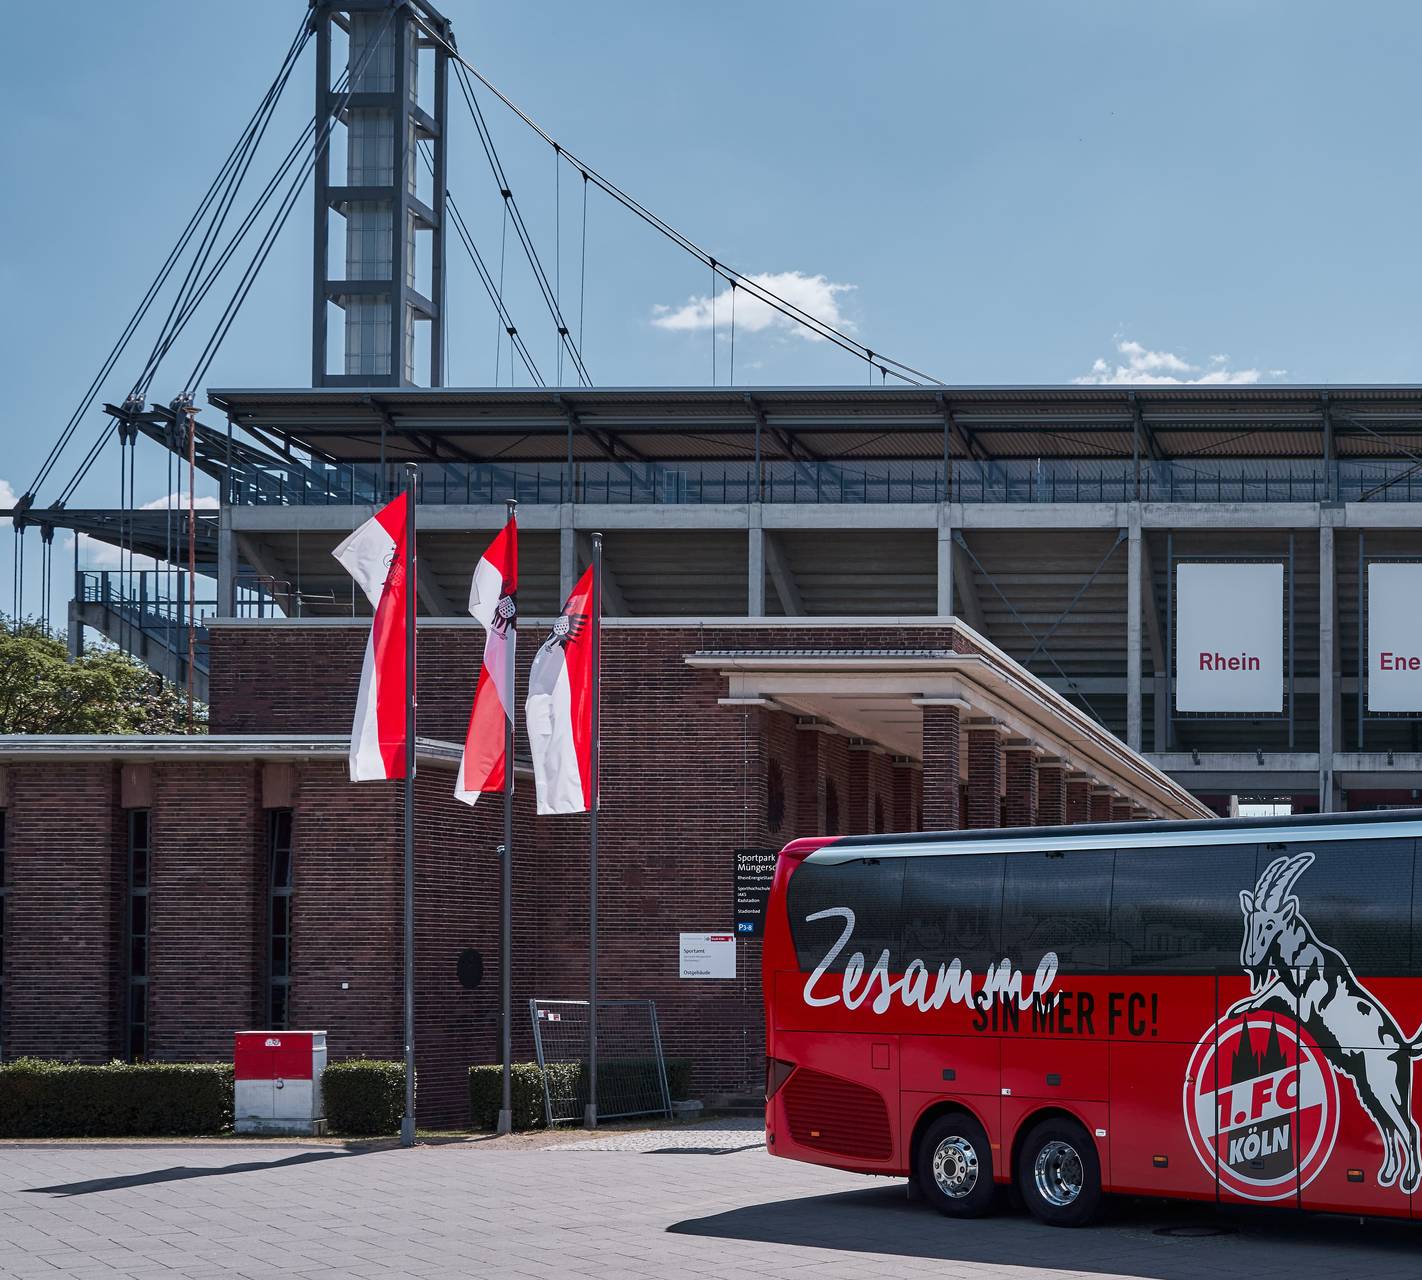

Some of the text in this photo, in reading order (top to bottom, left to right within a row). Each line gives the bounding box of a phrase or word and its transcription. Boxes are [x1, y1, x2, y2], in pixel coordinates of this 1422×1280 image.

[1199, 652, 1260, 671] Rhein
[737, 853, 776, 864] Sportpark
[972, 991, 1159, 1037] SIN MER FC!
[1229, 1124, 1290, 1166] KÖLN
